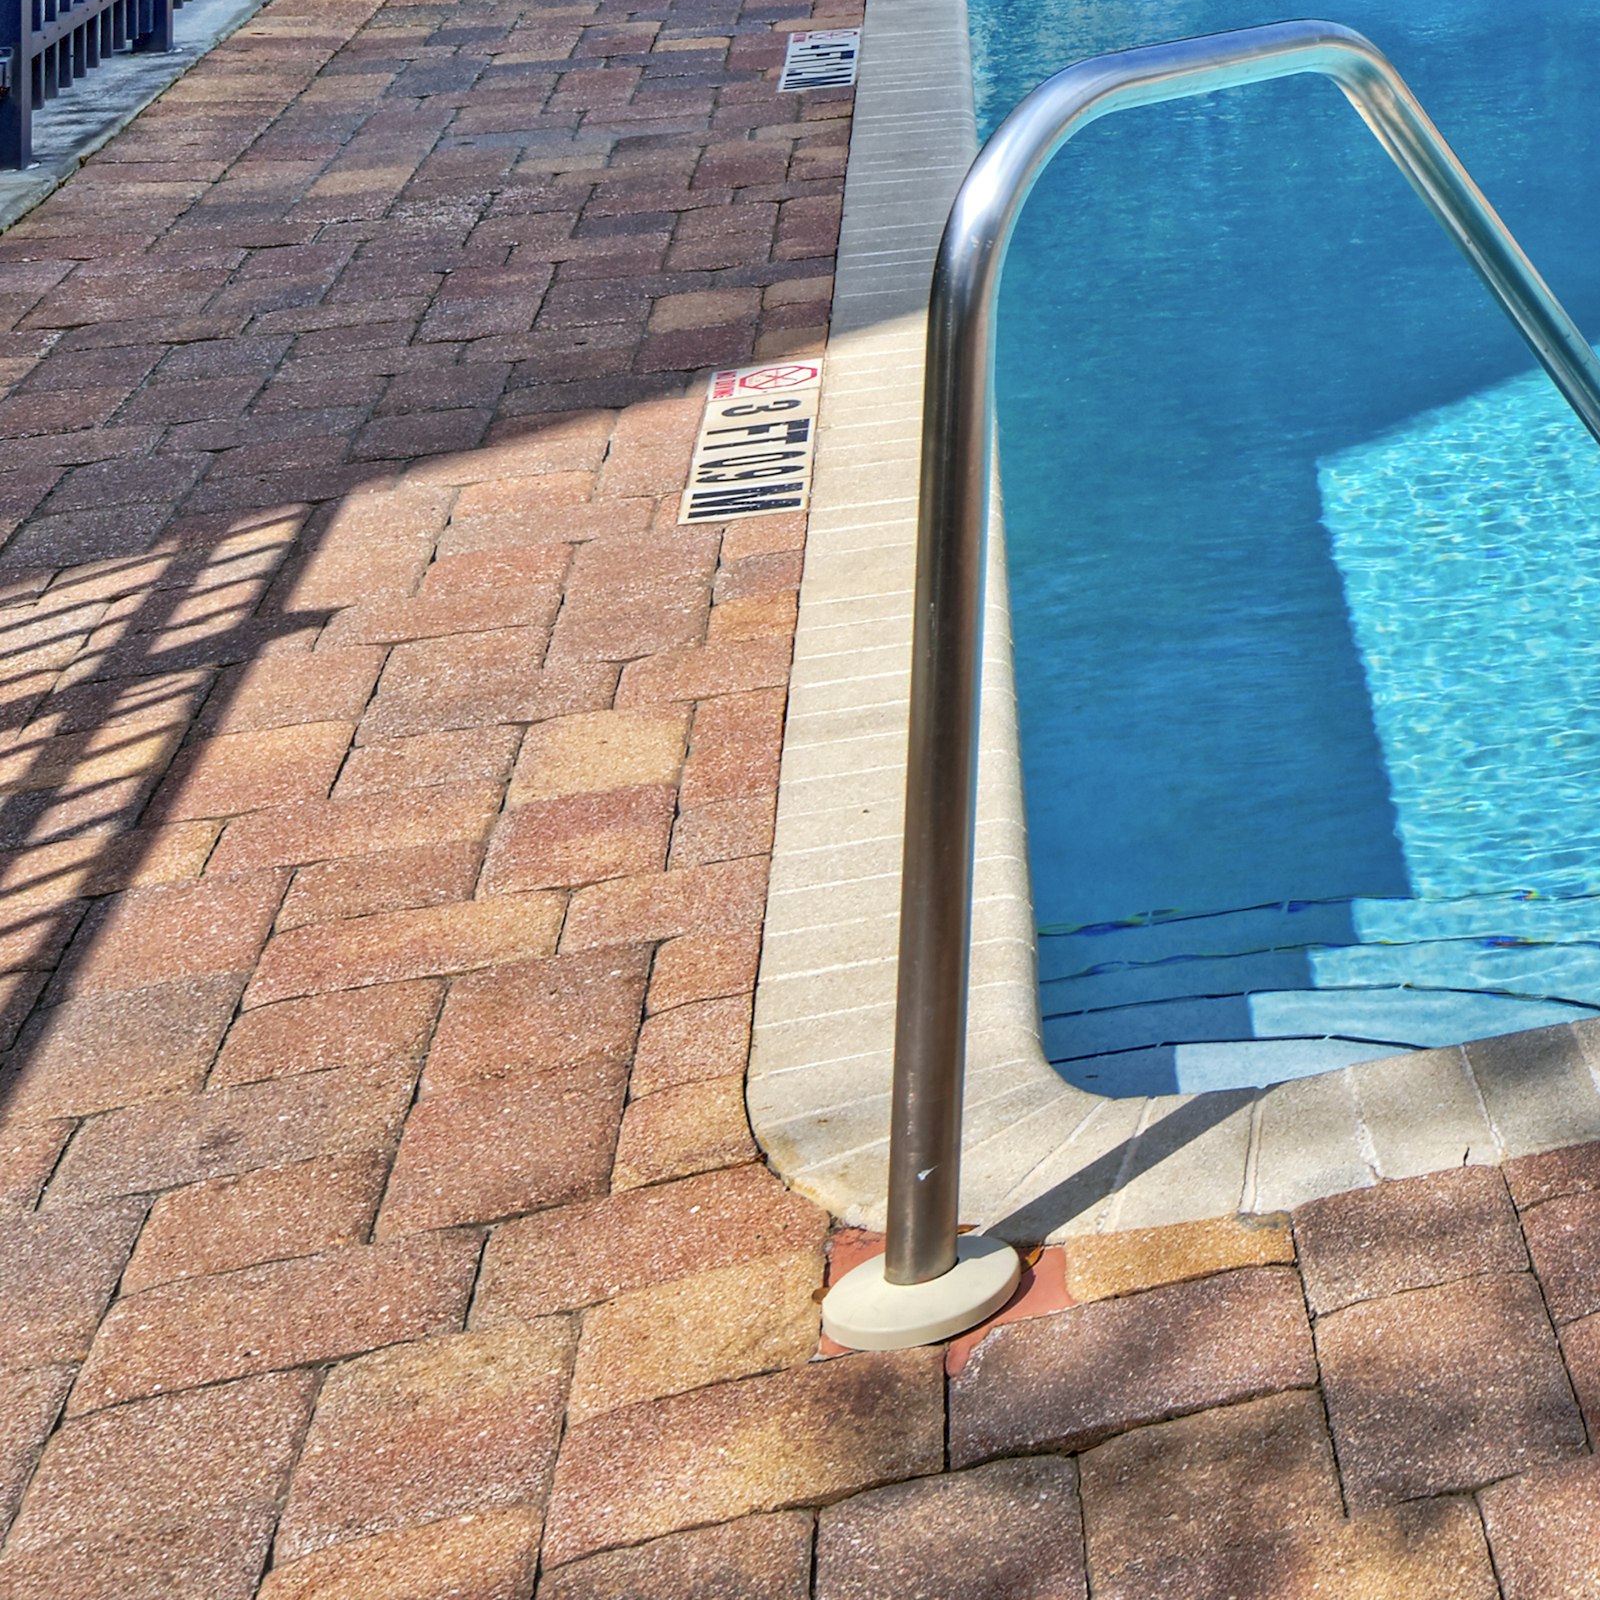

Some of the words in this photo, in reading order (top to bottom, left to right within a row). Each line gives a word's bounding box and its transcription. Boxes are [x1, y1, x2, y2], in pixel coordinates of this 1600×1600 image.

[721, 399, 802, 417] 3
[703, 418, 810, 451] FT
[688, 482, 804, 519] M
